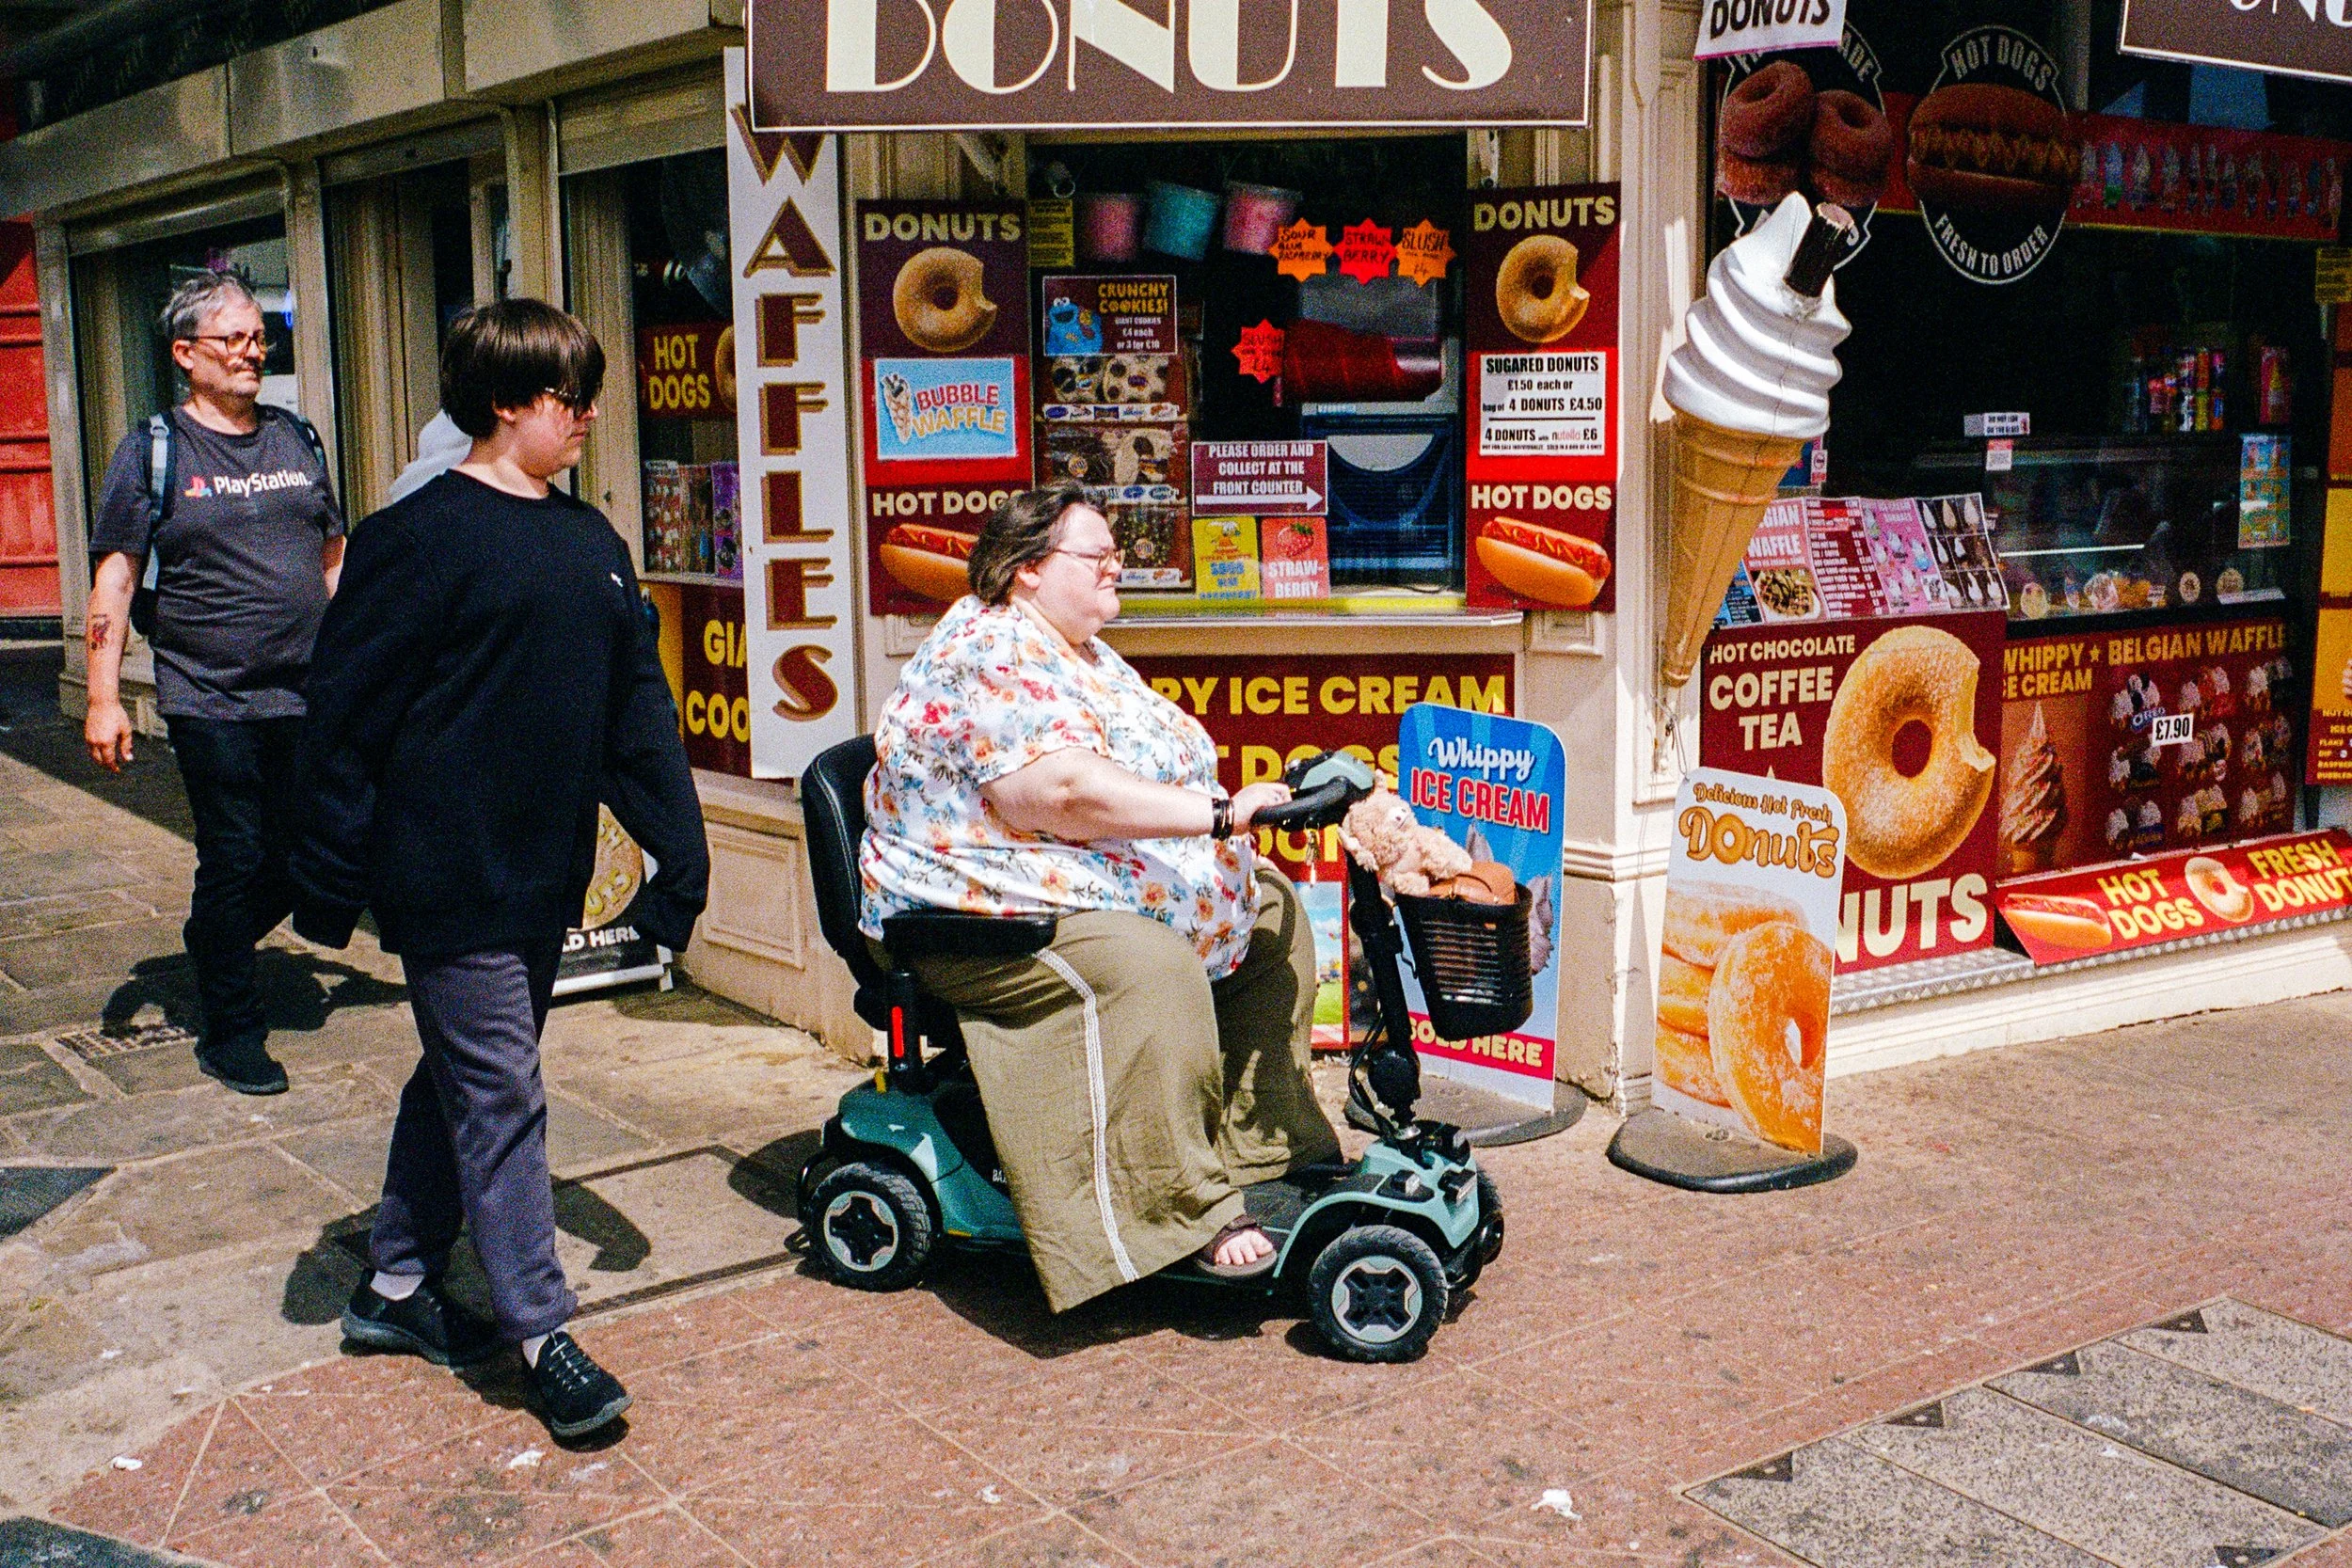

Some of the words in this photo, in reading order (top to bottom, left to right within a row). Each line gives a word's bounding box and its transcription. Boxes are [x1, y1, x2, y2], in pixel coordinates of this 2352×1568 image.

[826, 0, 1513, 93] DONUTS
[1949, 35, 1991, 80] HOT
[1997, 34, 2052, 91] DOGS
[865, 213, 1020, 242] DONUTS
[1474, 196, 1615, 231] DONUTS
[1934, 213, 1977, 271] FRESH
[1980, 252, 1998, 277] TO
[2002, 225, 2049, 275] ORDER
[1098, 283, 1168, 298] CRUNCHY
[654, 334, 698, 371] HOT
[1486, 357, 1544, 374] SUGARED
[1547, 356, 1599, 372] DONUTS
[649, 372, 710, 410] DOGS
[916, 384, 1000, 411] BUBBLE
[1507, 379, 1533, 391] £1.50
[1536, 379, 1561, 390] each
[1563, 380, 1573, 390] or
[1482, 403, 1496, 413] bag
[1497, 403, 1505, 412] of
[1508, 398, 1516, 411] 4
[1521, 398, 1565, 411] DONUTS
[1569, 397, 1602, 411] £4.50
[912, 406, 1008, 437] WAFFLE
[1485, 428, 1492, 441] 4
[1494, 429, 1535, 441] DONUTS
[1551, 430, 1581, 441] nutella
[1582, 428, 1597, 440] £6
[1209, 443, 1248, 458] PLEASE
[1251, 443, 1288, 457] ORDER
[1290, 443, 1313, 456] AND
[1218, 461, 1266, 475] COLLECT
[1268, 461, 1282, 475] AT
[1283, 461, 1305, 474] THE
[213, 469, 309, 498] PlayStation
[1213, 481, 1249, 495] FRONT
[1251, 481, 1303, 495] COUNTER
[1471, 484, 1529, 509] HOT
[1533, 484, 1613, 511] DOGS
[872, 492, 936, 516] HOT
[1269, 560, 1324, 577] STRAW-
[1275, 581, 1319, 598] BERRY
[1709, 642, 1747, 664] HOT
[1750, 634, 1855, 660] CHOCOLATE
[2108, 631, 2201, 665] BELGIAN
[1231, 676, 1309, 715] ICE
[1317, 676, 1505, 715] CREAM
[1708, 666, 1834, 710] COFFEE
[2021, 668, 2092, 697] CREAM
[1739, 711, 1803, 751] TEA
[2154, 717, 2190, 740] £7.90
[1427, 736, 1535, 783] Whippy
[1411, 767, 1453, 814] ICE
[1456, 776, 1551, 834] CREAM
[1692, 782, 1758, 810] Delicious
[1760, 793, 1788, 816] Hot
[1790, 799, 1833, 828] Fresh
[2096, 868, 2169, 908] HOT
[2247, 838, 2344, 880] FRESH
[2106, 897, 2205, 941] DOGS
[2253, 866, 2352, 912] DONUT
[1470, 1034, 1544, 1068] HERE
